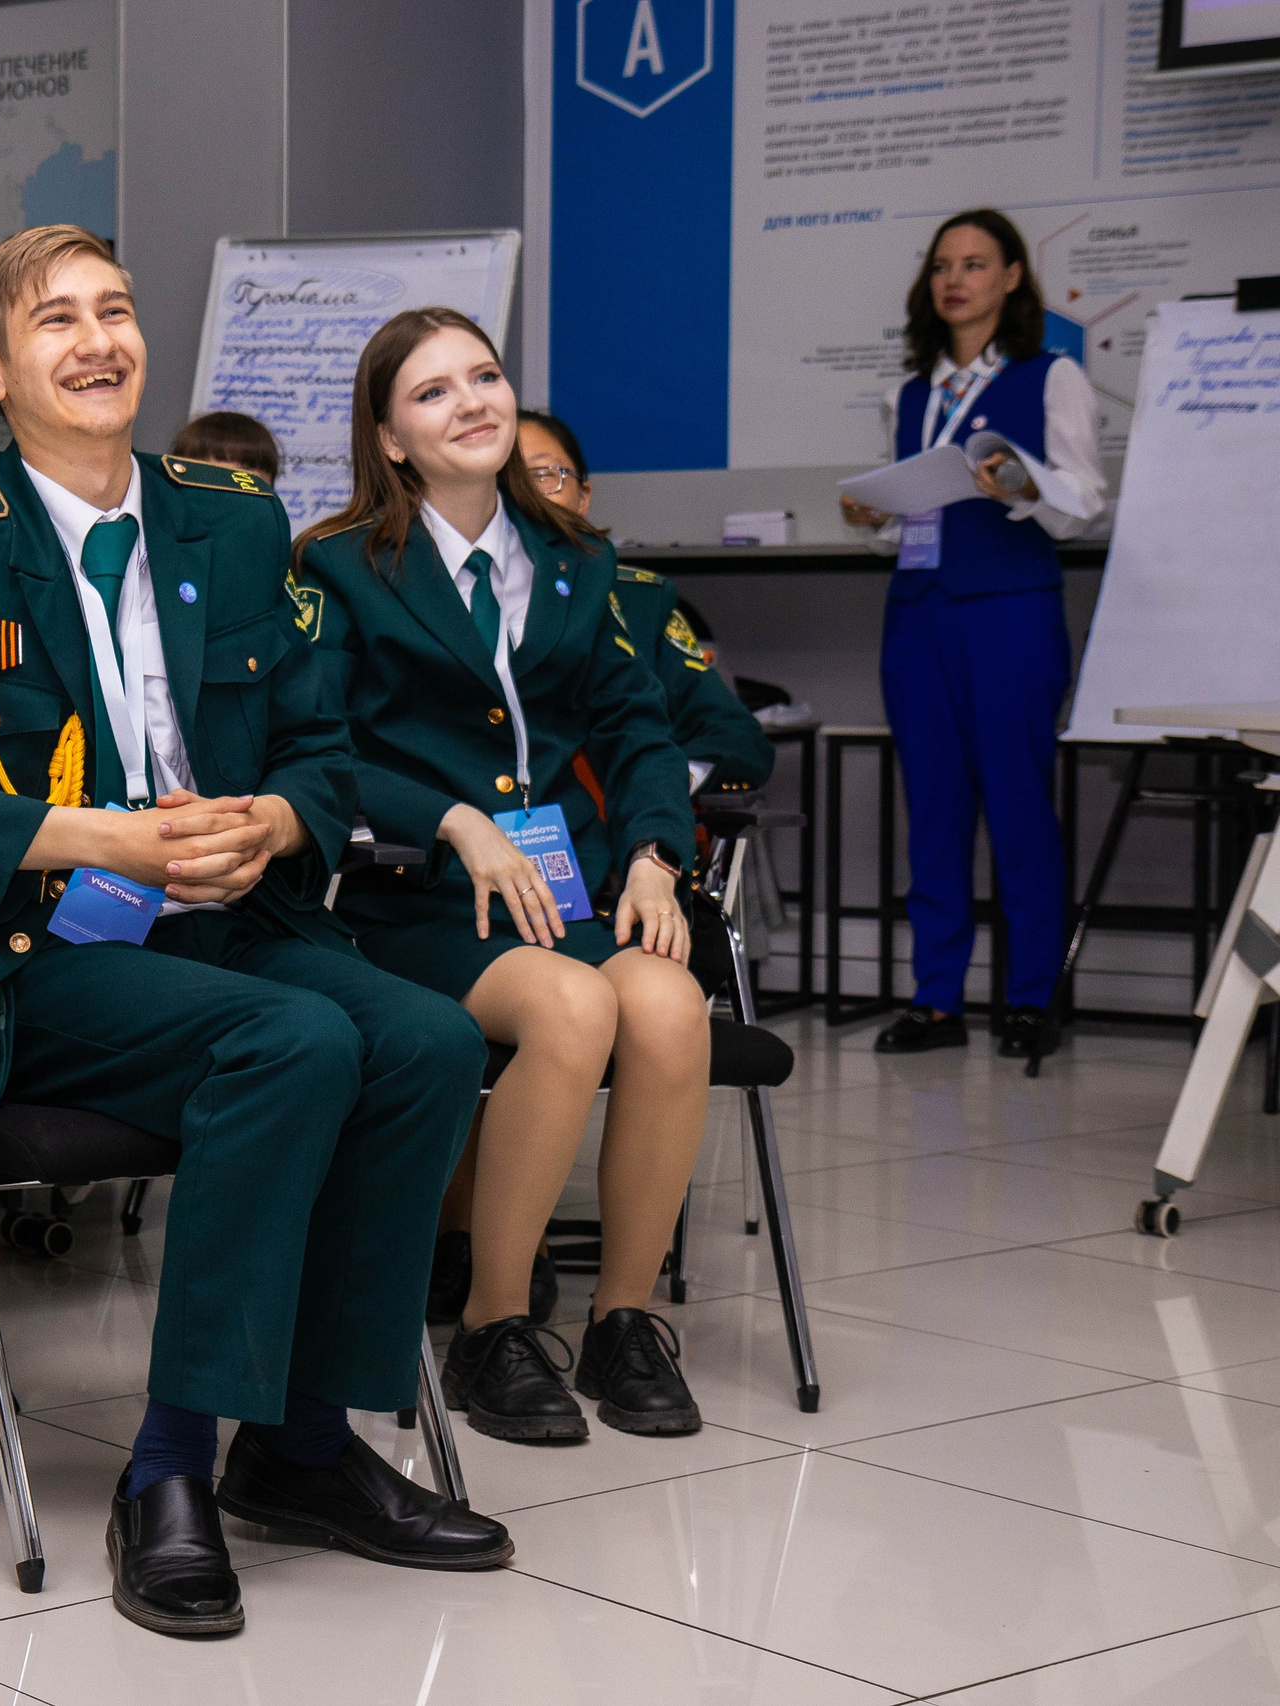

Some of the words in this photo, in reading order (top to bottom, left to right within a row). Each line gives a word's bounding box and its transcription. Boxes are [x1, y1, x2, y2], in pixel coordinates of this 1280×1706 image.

[763, 215, 793, 231] ДЛЯ
[795, 211, 830, 227] КОГО
[832, 206, 885, 223] АТЛАС?
[234, 279, 358, 317] Проблема
[505, 830, 521, 839] Не
[521, 824, 560, 838] работа,
[521, 833, 559, 847] миссия
[91, 875, 143, 908] УЧАСТНИК
